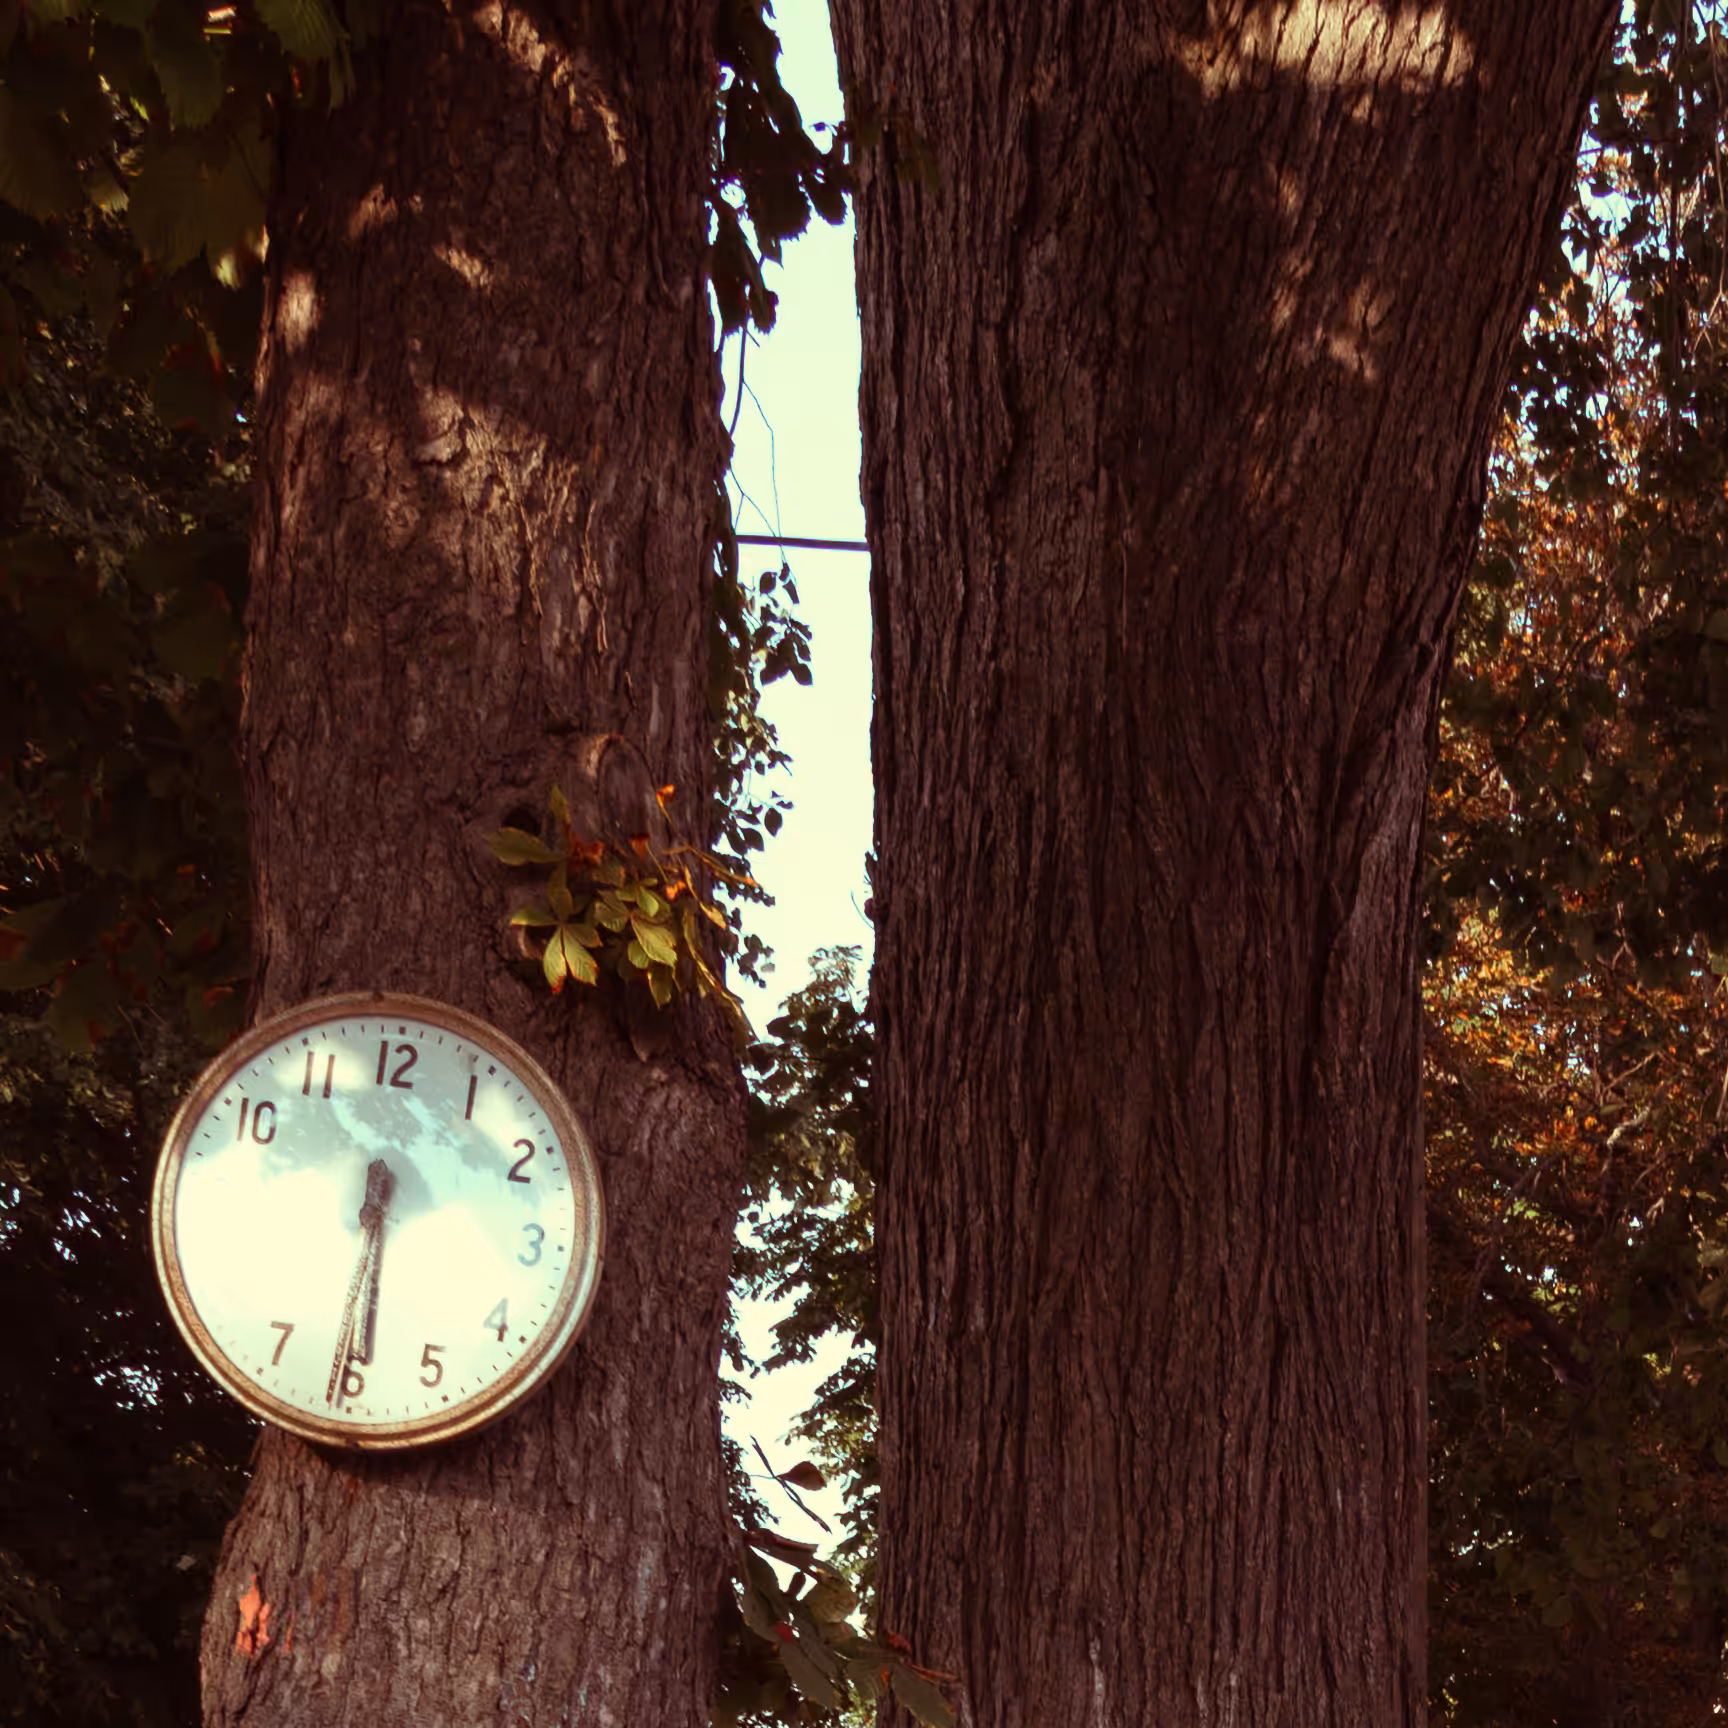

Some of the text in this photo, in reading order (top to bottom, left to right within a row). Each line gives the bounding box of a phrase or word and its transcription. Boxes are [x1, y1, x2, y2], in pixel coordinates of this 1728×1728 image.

[301, 1050, 336, 1099] 11
[375, 1039, 419, 1090] 12
[236, 1096, 278, 1145] 10
[464, 1074, 478, 1121] 1
[506, 1137, 537, 1184] 2
[516, 1222, 546, 1267] 3
[269, 1320, 295, 1366] 7
[483, 1297, 509, 1342] 4
[340, 1356, 366, 1398] 6
[419, 1342, 448, 1389] 5
